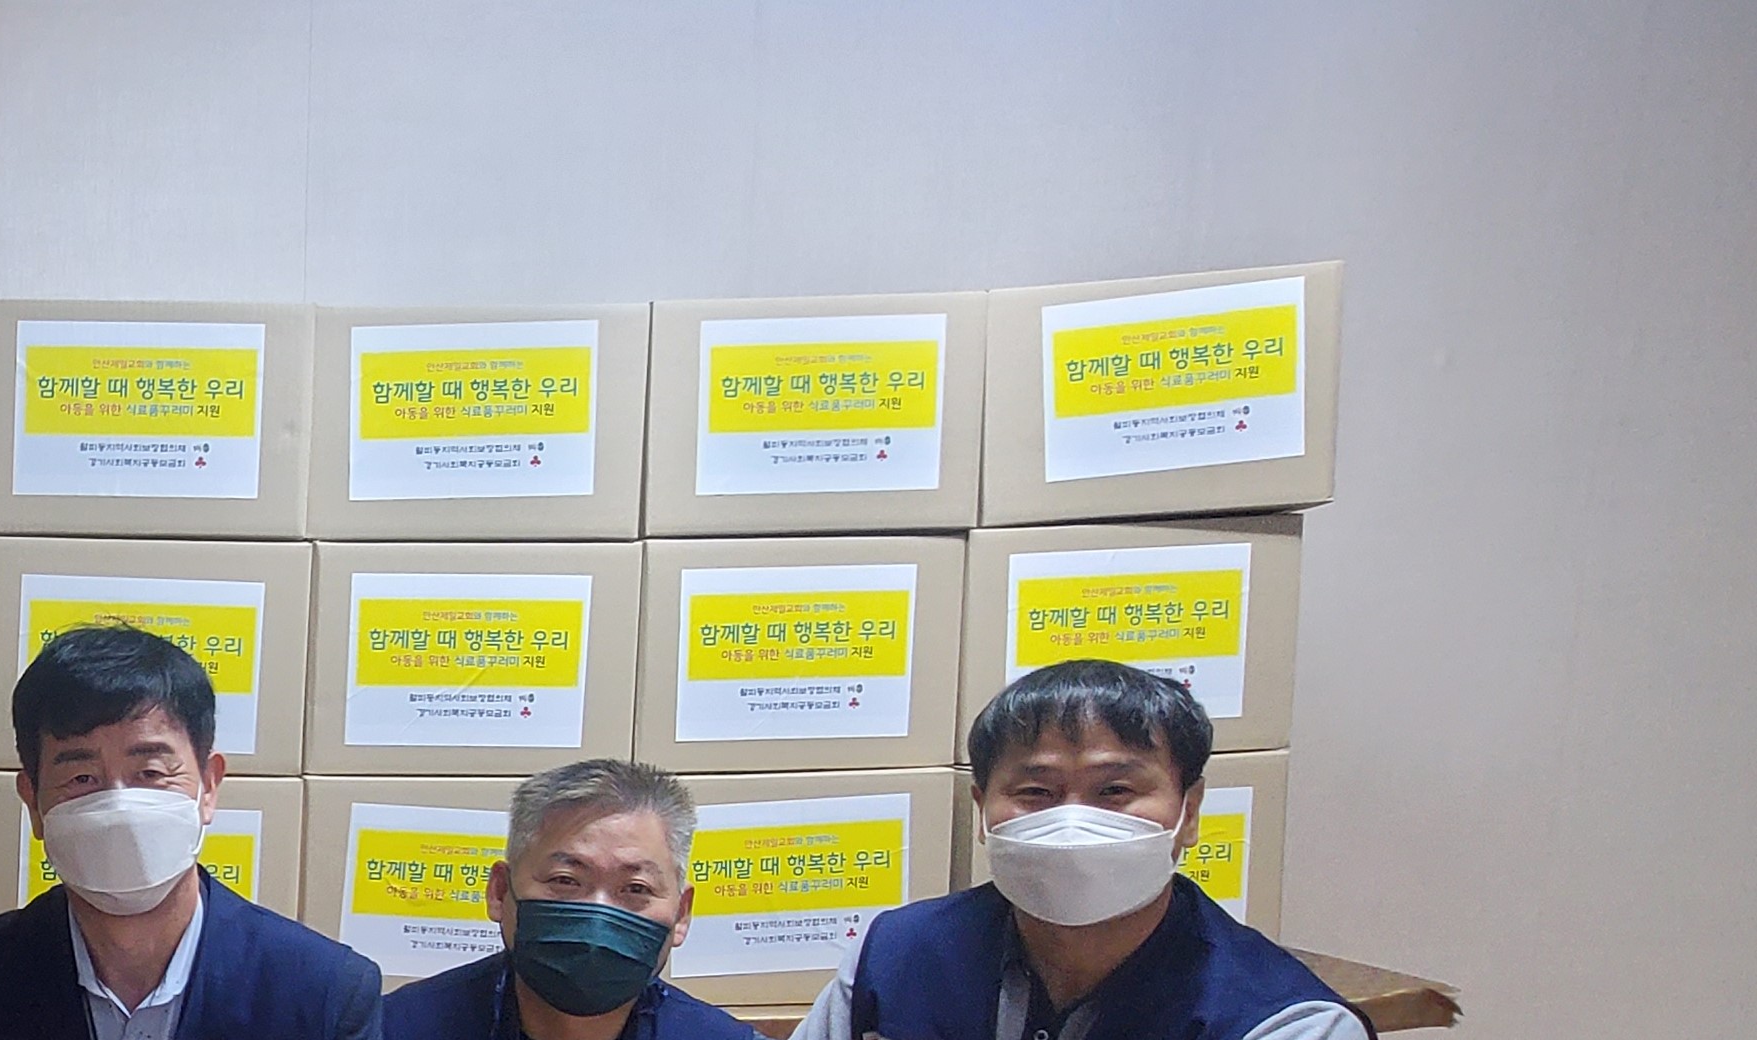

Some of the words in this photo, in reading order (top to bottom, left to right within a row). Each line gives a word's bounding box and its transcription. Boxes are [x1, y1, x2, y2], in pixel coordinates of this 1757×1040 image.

[1066, 352, 1132, 382] 함께할
[1139, 350, 1160, 372] 때
[1168, 341, 1234, 371] 행복한
[1241, 336, 1283, 361] 우리
[1234, 365, 1259, 381] 지원
[37, 375, 101, 399] 함께할
[107, 378, 128, 397] 때
[135, 377, 197, 401] 행복한
[204, 379, 243, 400] 우리
[372, 380, 435, 404] 함께할
[442, 380, 462, 400] 때
[469, 377, 531, 401] 행복한
[538, 377, 577, 398] 우리
[721, 374, 783, 398] 함께할
[790, 374, 810, 394] 때
[818, 371, 879, 395] 행복한
[886, 371, 924, 391] 우리
[99, 403, 121, 416] 위한
[196, 404, 220, 418] 지원
[433, 405, 456, 419] 위한
[531, 403, 554, 417] 지원
[1028, 605, 1090, 631] 함께할
[1096, 605, 1116, 625] 때
[1123, 601, 1184, 626] 행복한
[1190, 599, 1228, 621] 우리
[369, 628, 431, 650] 함께할
[437, 629, 456, 649] 때
[463, 629, 525, 651] 행복한
[530, 630, 568, 651] 우리
[699, 622, 760, 646] 함께할
[766, 622, 786, 642] 때
[792, 620, 852, 644] 행복한
[858, 620, 895, 641] 우리
[204, 636, 242, 657] 우리
[757, 648, 780, 661] 위한
[851, 645, 873, 659] 지원
[522, 655, 546, 668] 지원
[1196, 842, 1232, 864] 우리
[365, 858, 427, 883] 함께할
[433, 863, 453, 883] 때
[691, 857, 753, 882] 함께할
[760, 856, 779, 876] 때
[786, 851, 846, 876] 행복한
[853, 849, 890, 871] 우리
[1189, 869, 1210, 882] 지원
[846, 876, 868, 889] 지원
